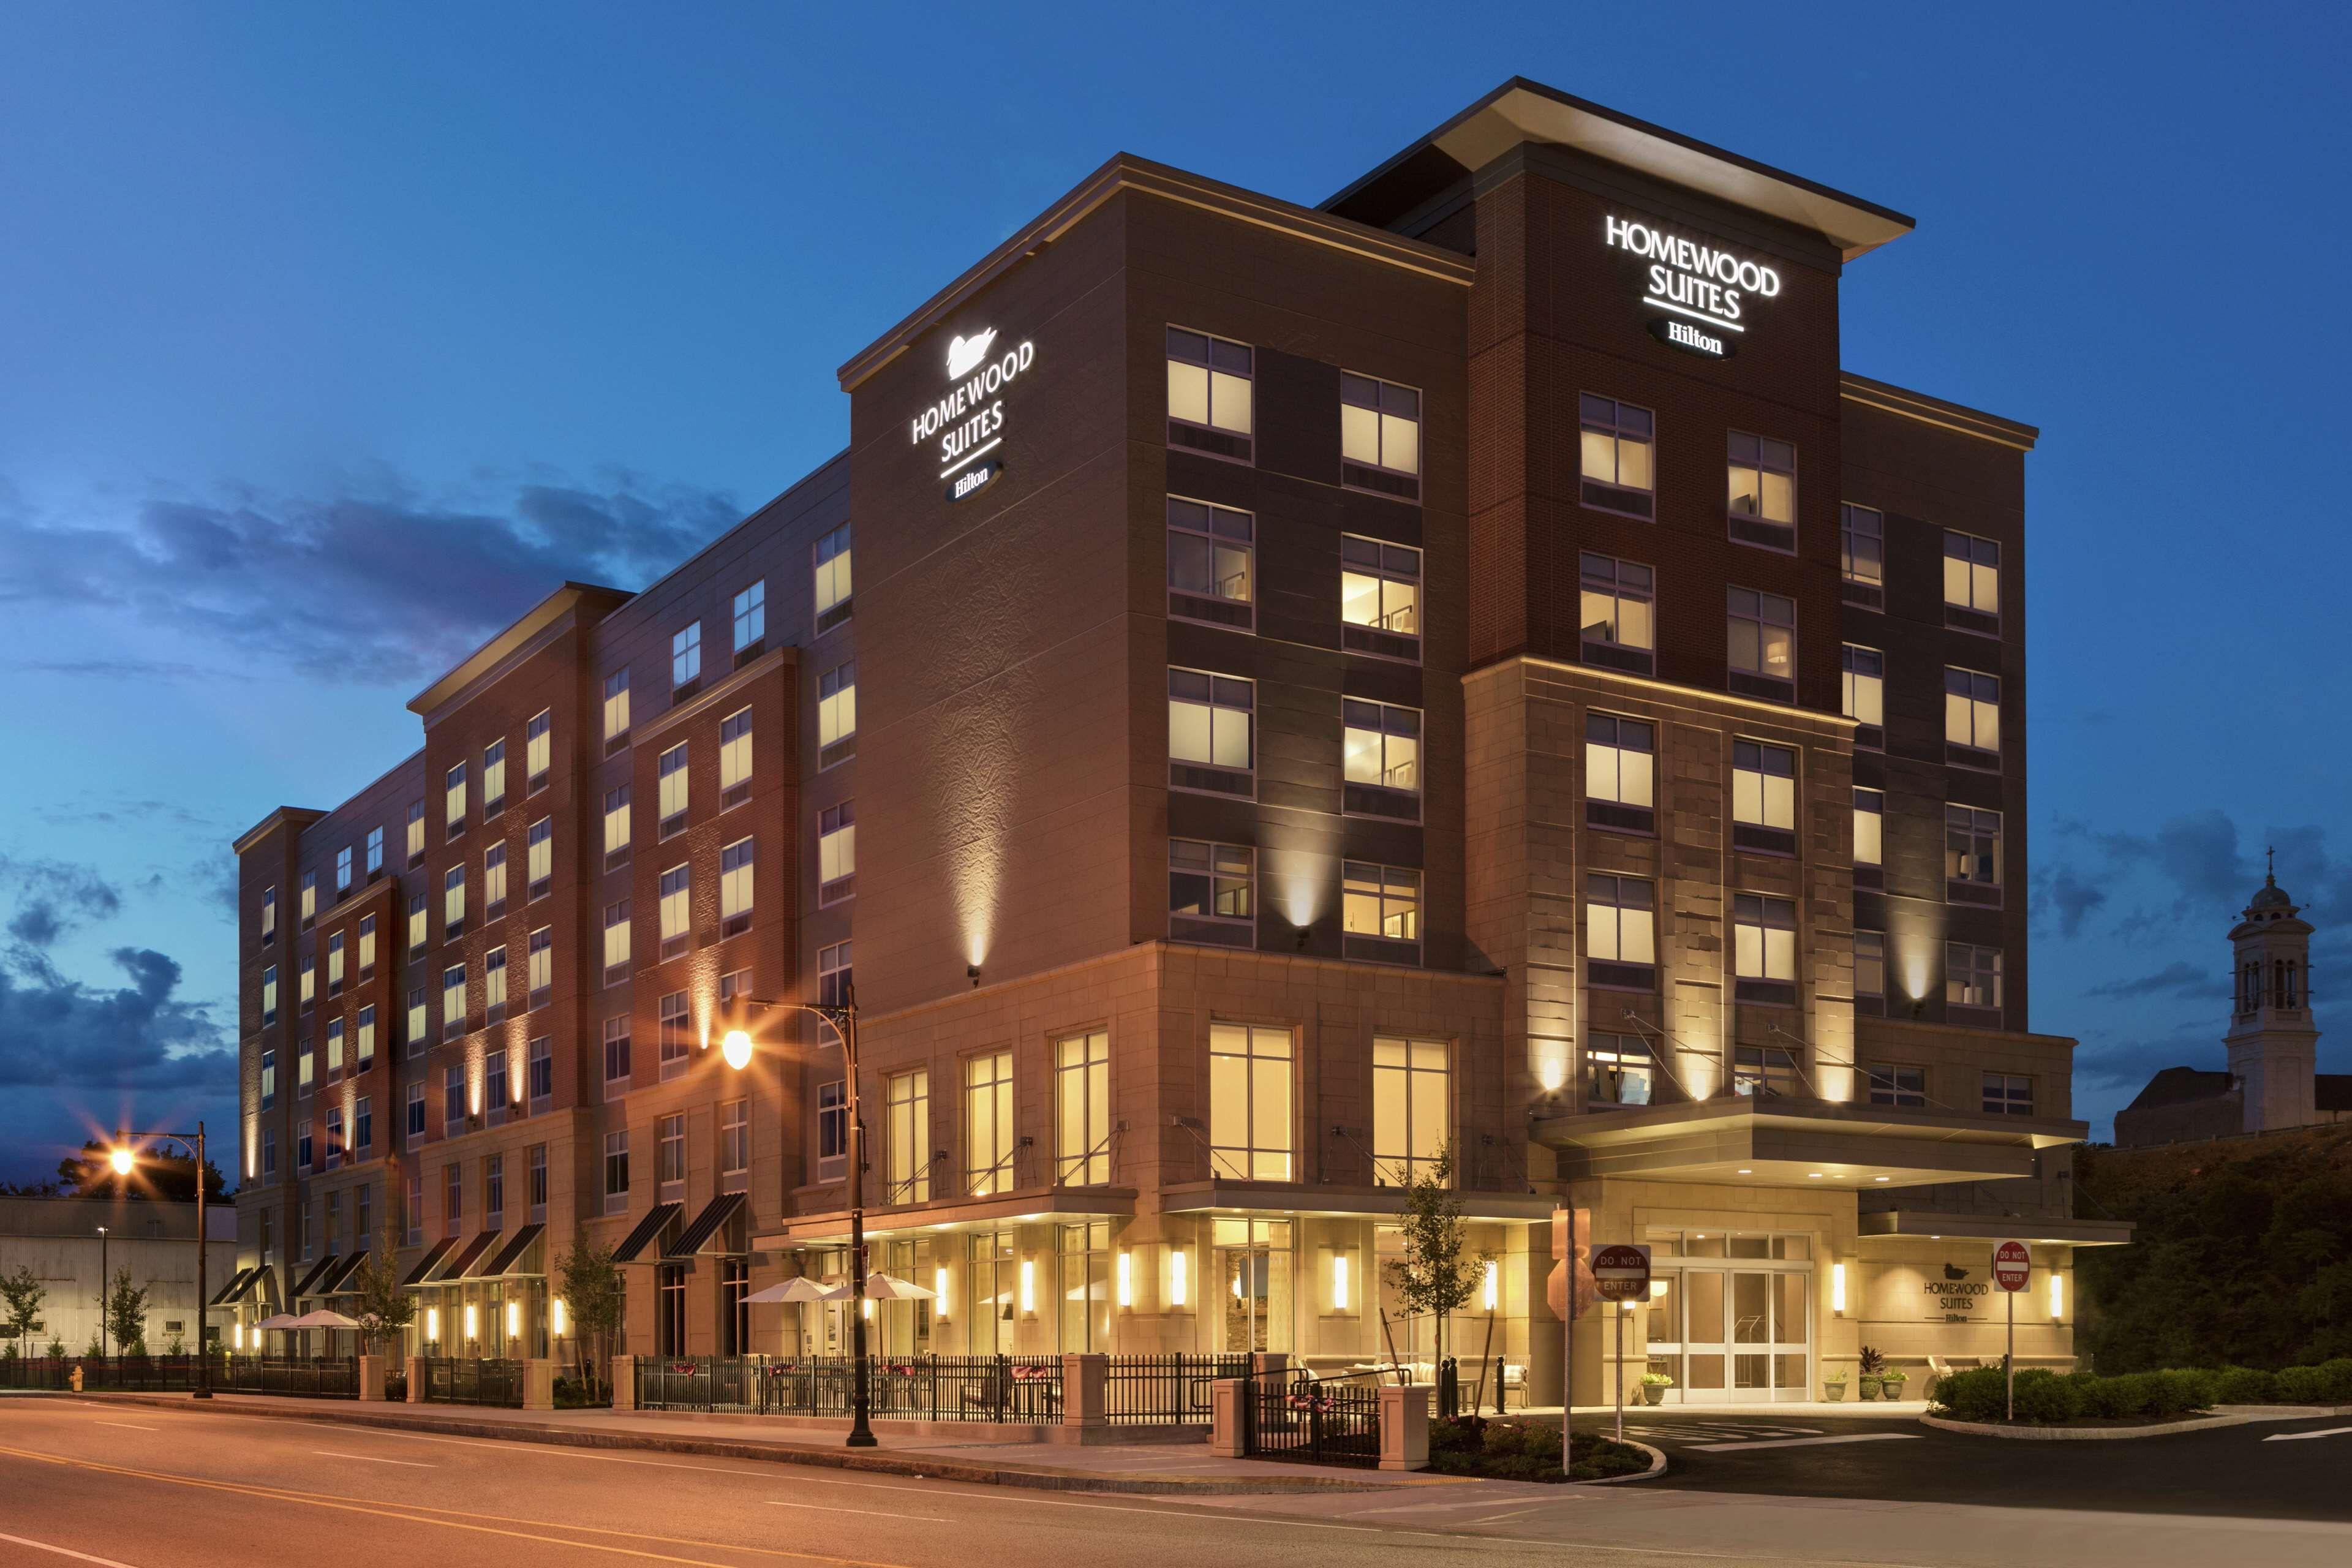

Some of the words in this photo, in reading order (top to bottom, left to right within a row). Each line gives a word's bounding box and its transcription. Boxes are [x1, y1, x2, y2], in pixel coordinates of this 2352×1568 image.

[1606, 215, 1780, 296] HOMEWOOD
[1649, 265, 1741, 319] SUITES
[1668, 322, 1723, 355] Hilton
[913, 341, 1033, 445] HOMEWOOD
[941, 401, 1002, 462] SUITES
[955, 467, 988, 499] Hilton
[1600, 1256, 1614, 1265] DO
[1621, 1256, 1642, 1265] NOT
[1604, 1281, 1637, 1291] ENTER
[2002, 1273, 2022, 1282] ENTER
[1924, 1283, 1989, 1295] HOMEWOOD
[1940, 1297, 1973, 1310] SUITES
[1945, 1314, 1967, 1323] Hilton
